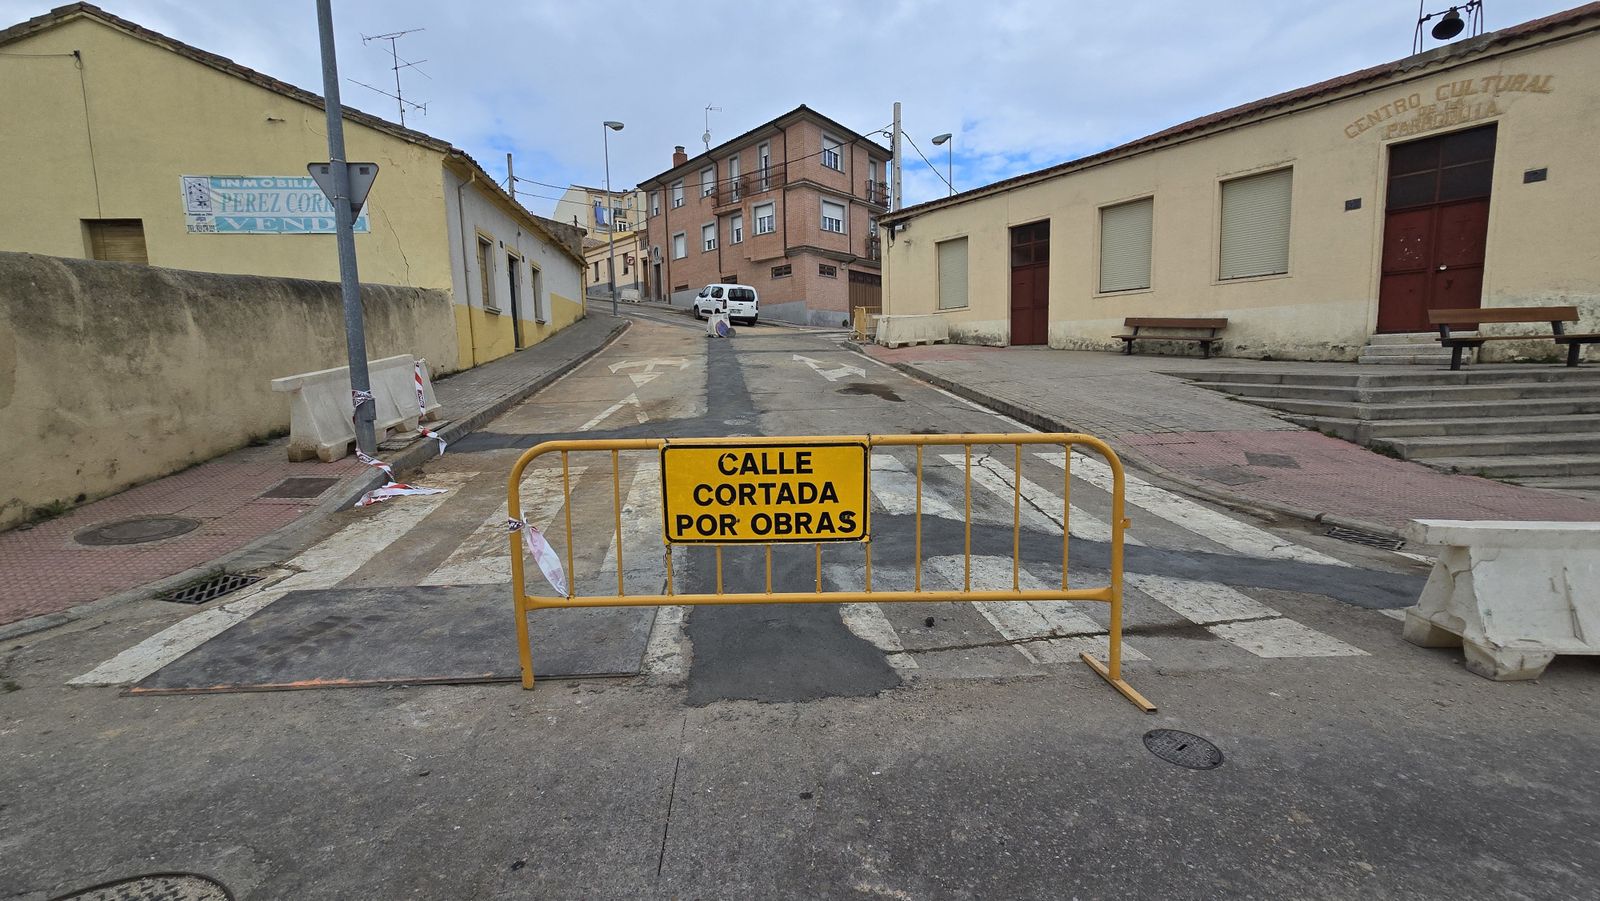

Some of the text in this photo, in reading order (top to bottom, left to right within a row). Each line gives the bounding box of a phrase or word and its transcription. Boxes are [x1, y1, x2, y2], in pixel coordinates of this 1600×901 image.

[1344, 74, 1554, 138] CENTRO CULTURAL
[221, 178, 319, 189] INMOBILIA
[221, 193, 281, 213] PEREZ
[718, 452, 813, 475] CALLE
[693, 482, 838, 506] CORTADA
[676, 511, 856, 536] POR OBRAS
